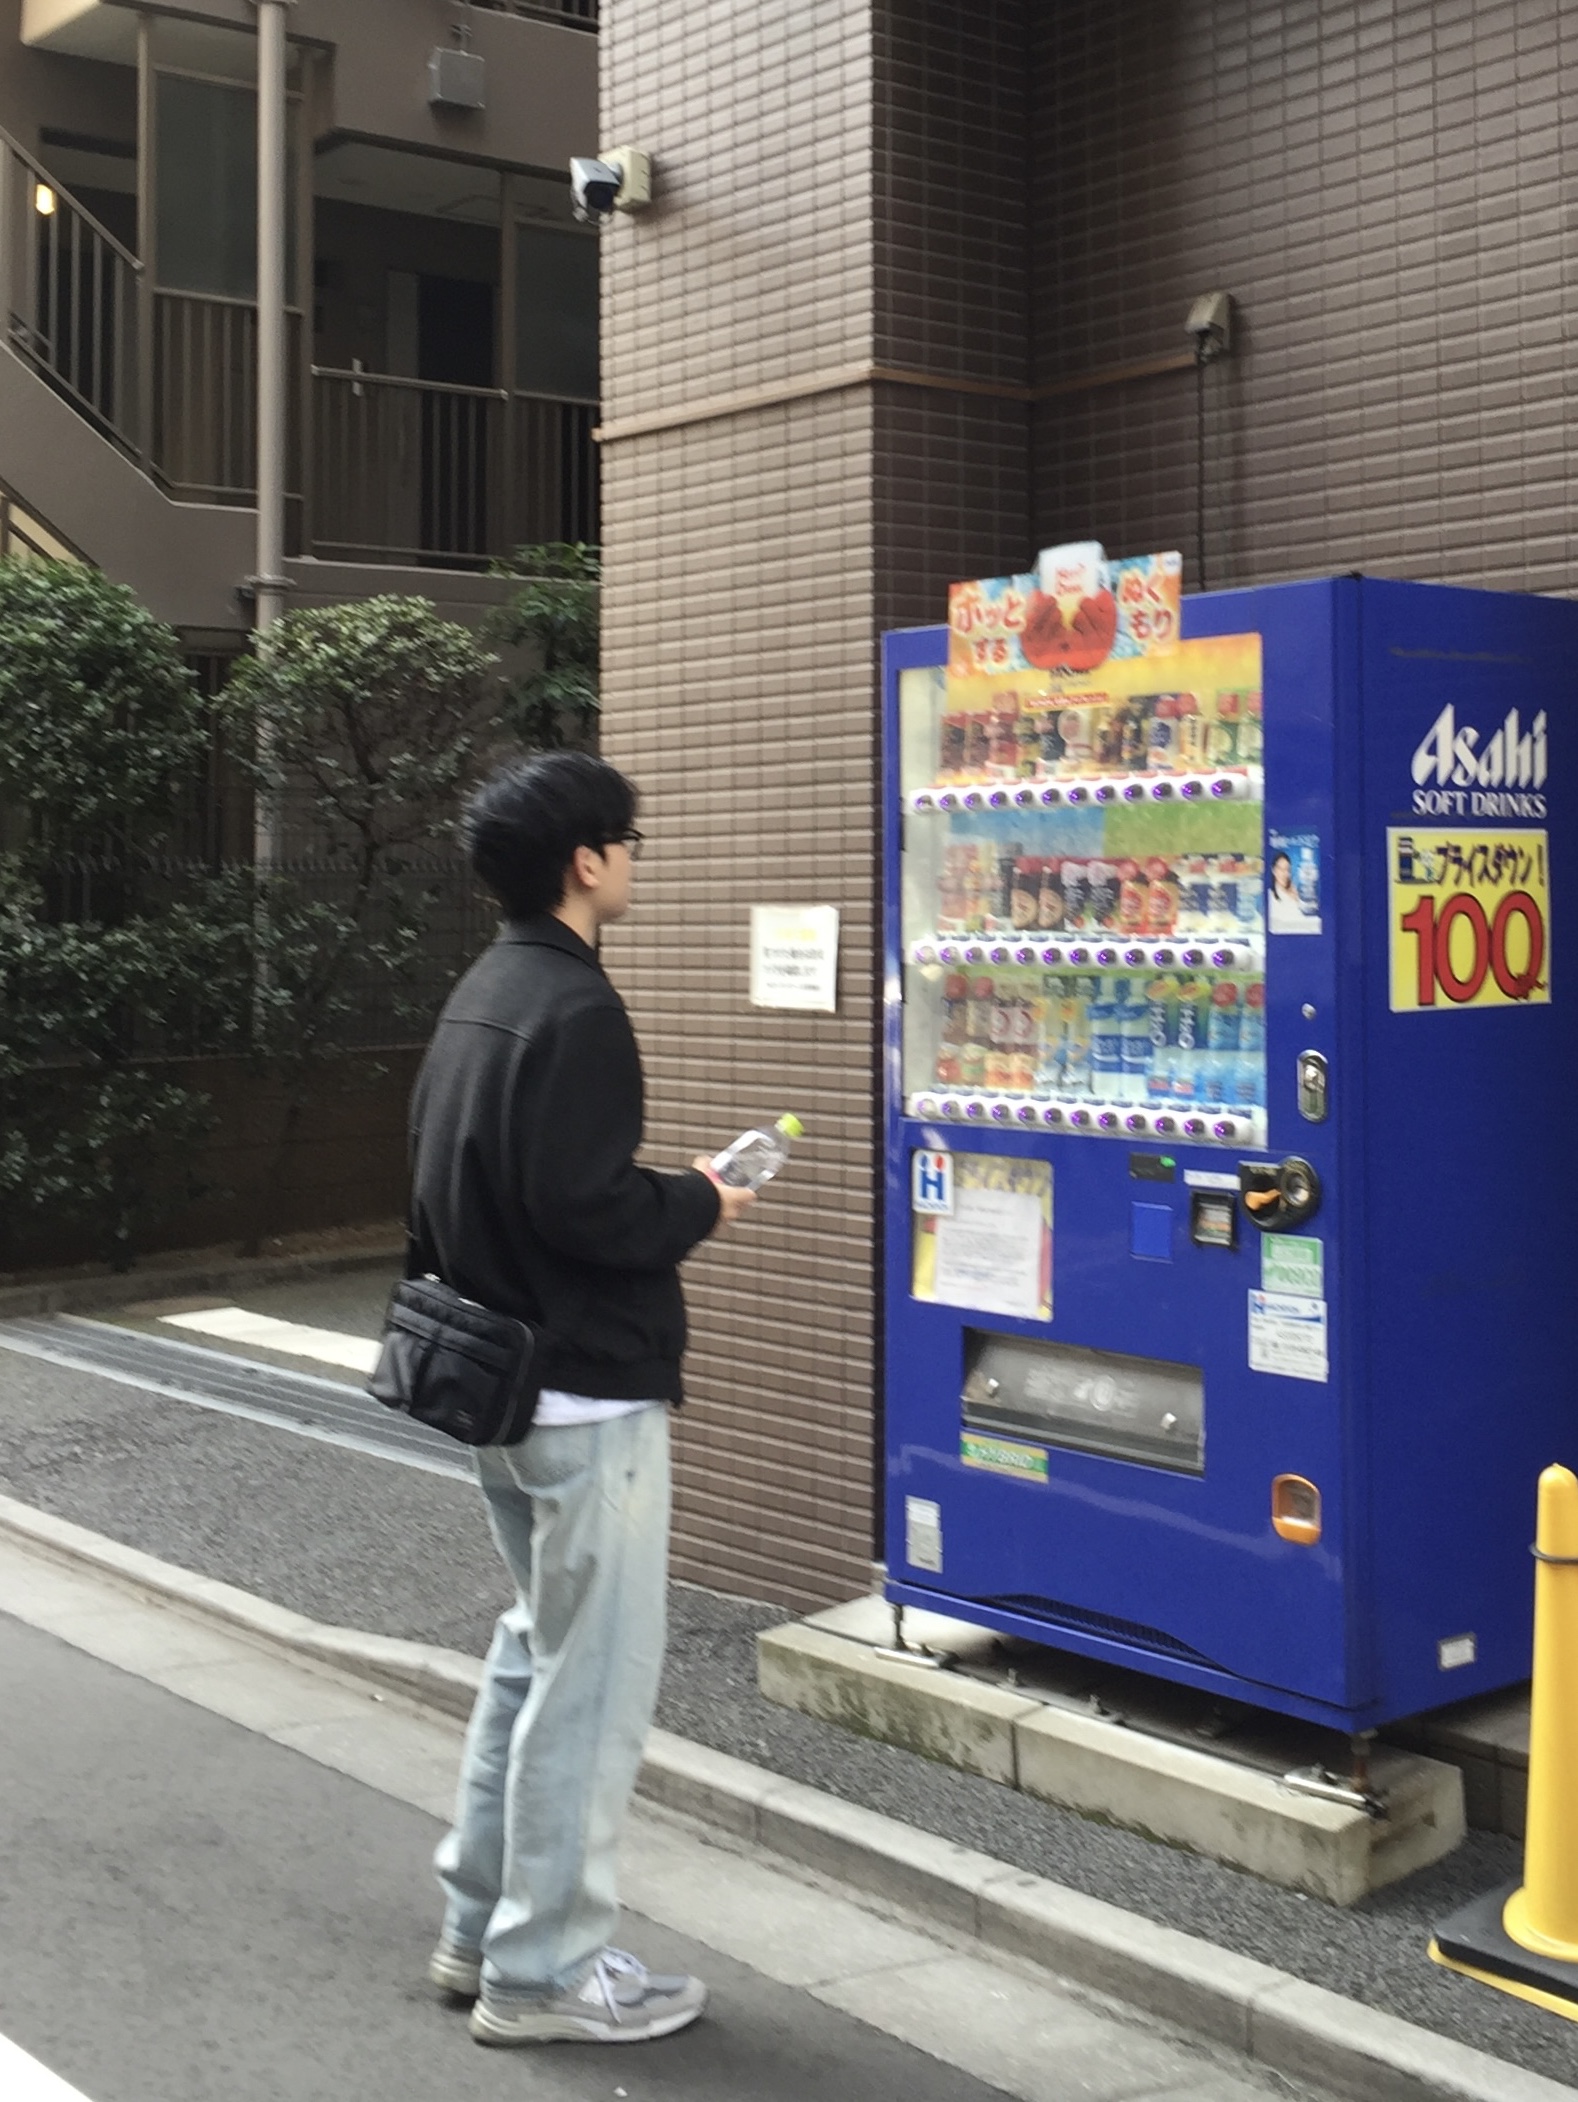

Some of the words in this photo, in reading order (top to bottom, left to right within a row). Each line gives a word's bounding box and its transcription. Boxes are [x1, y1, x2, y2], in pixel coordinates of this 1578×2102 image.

[1131, 608, 1172, 640] もり
[1411, 702, 1547, 790] Asahi
[1412, 789, 1468, 816] SOFT
[1471, 790, 1547, 819] DRINKS
